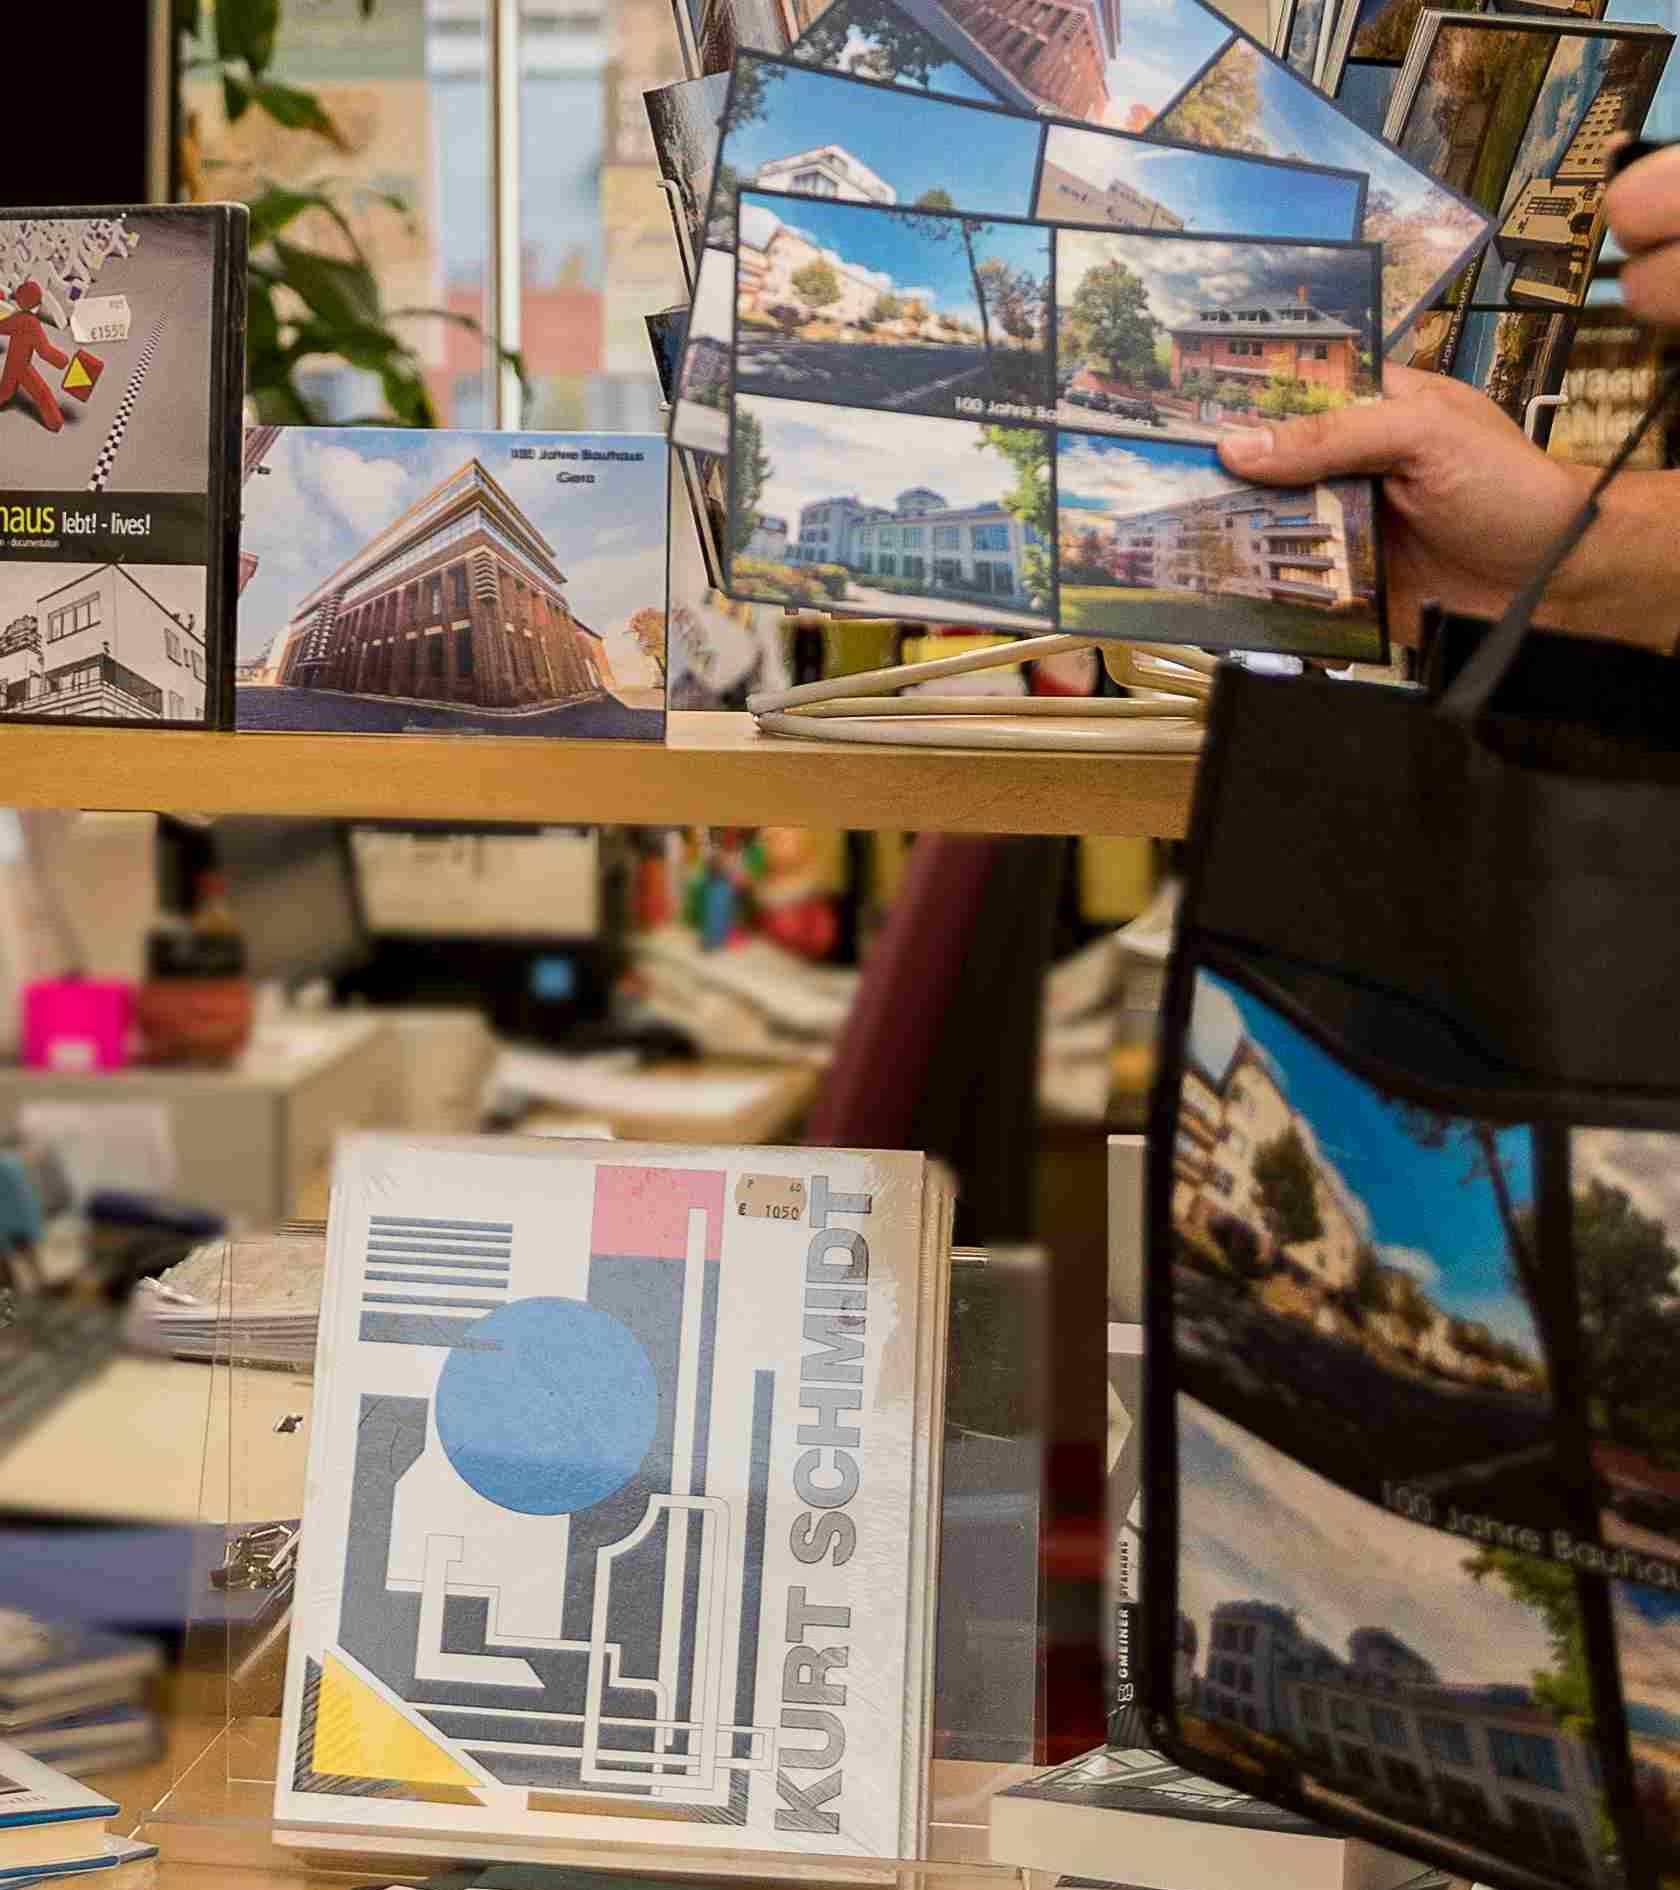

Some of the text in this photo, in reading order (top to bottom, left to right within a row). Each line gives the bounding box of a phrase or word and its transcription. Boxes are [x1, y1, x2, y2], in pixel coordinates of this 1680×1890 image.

[61, 512, 97, 534] lebt!
[111, 513, 152, 535] lives!
[738, 1202, 747, 1216] €
[773, 1174, 873, 1836] KURT SCHMIDT
[1446, 1505, 1542, 1554] Jahre
[1118, 1609, 1129, 1678] GMEINER
